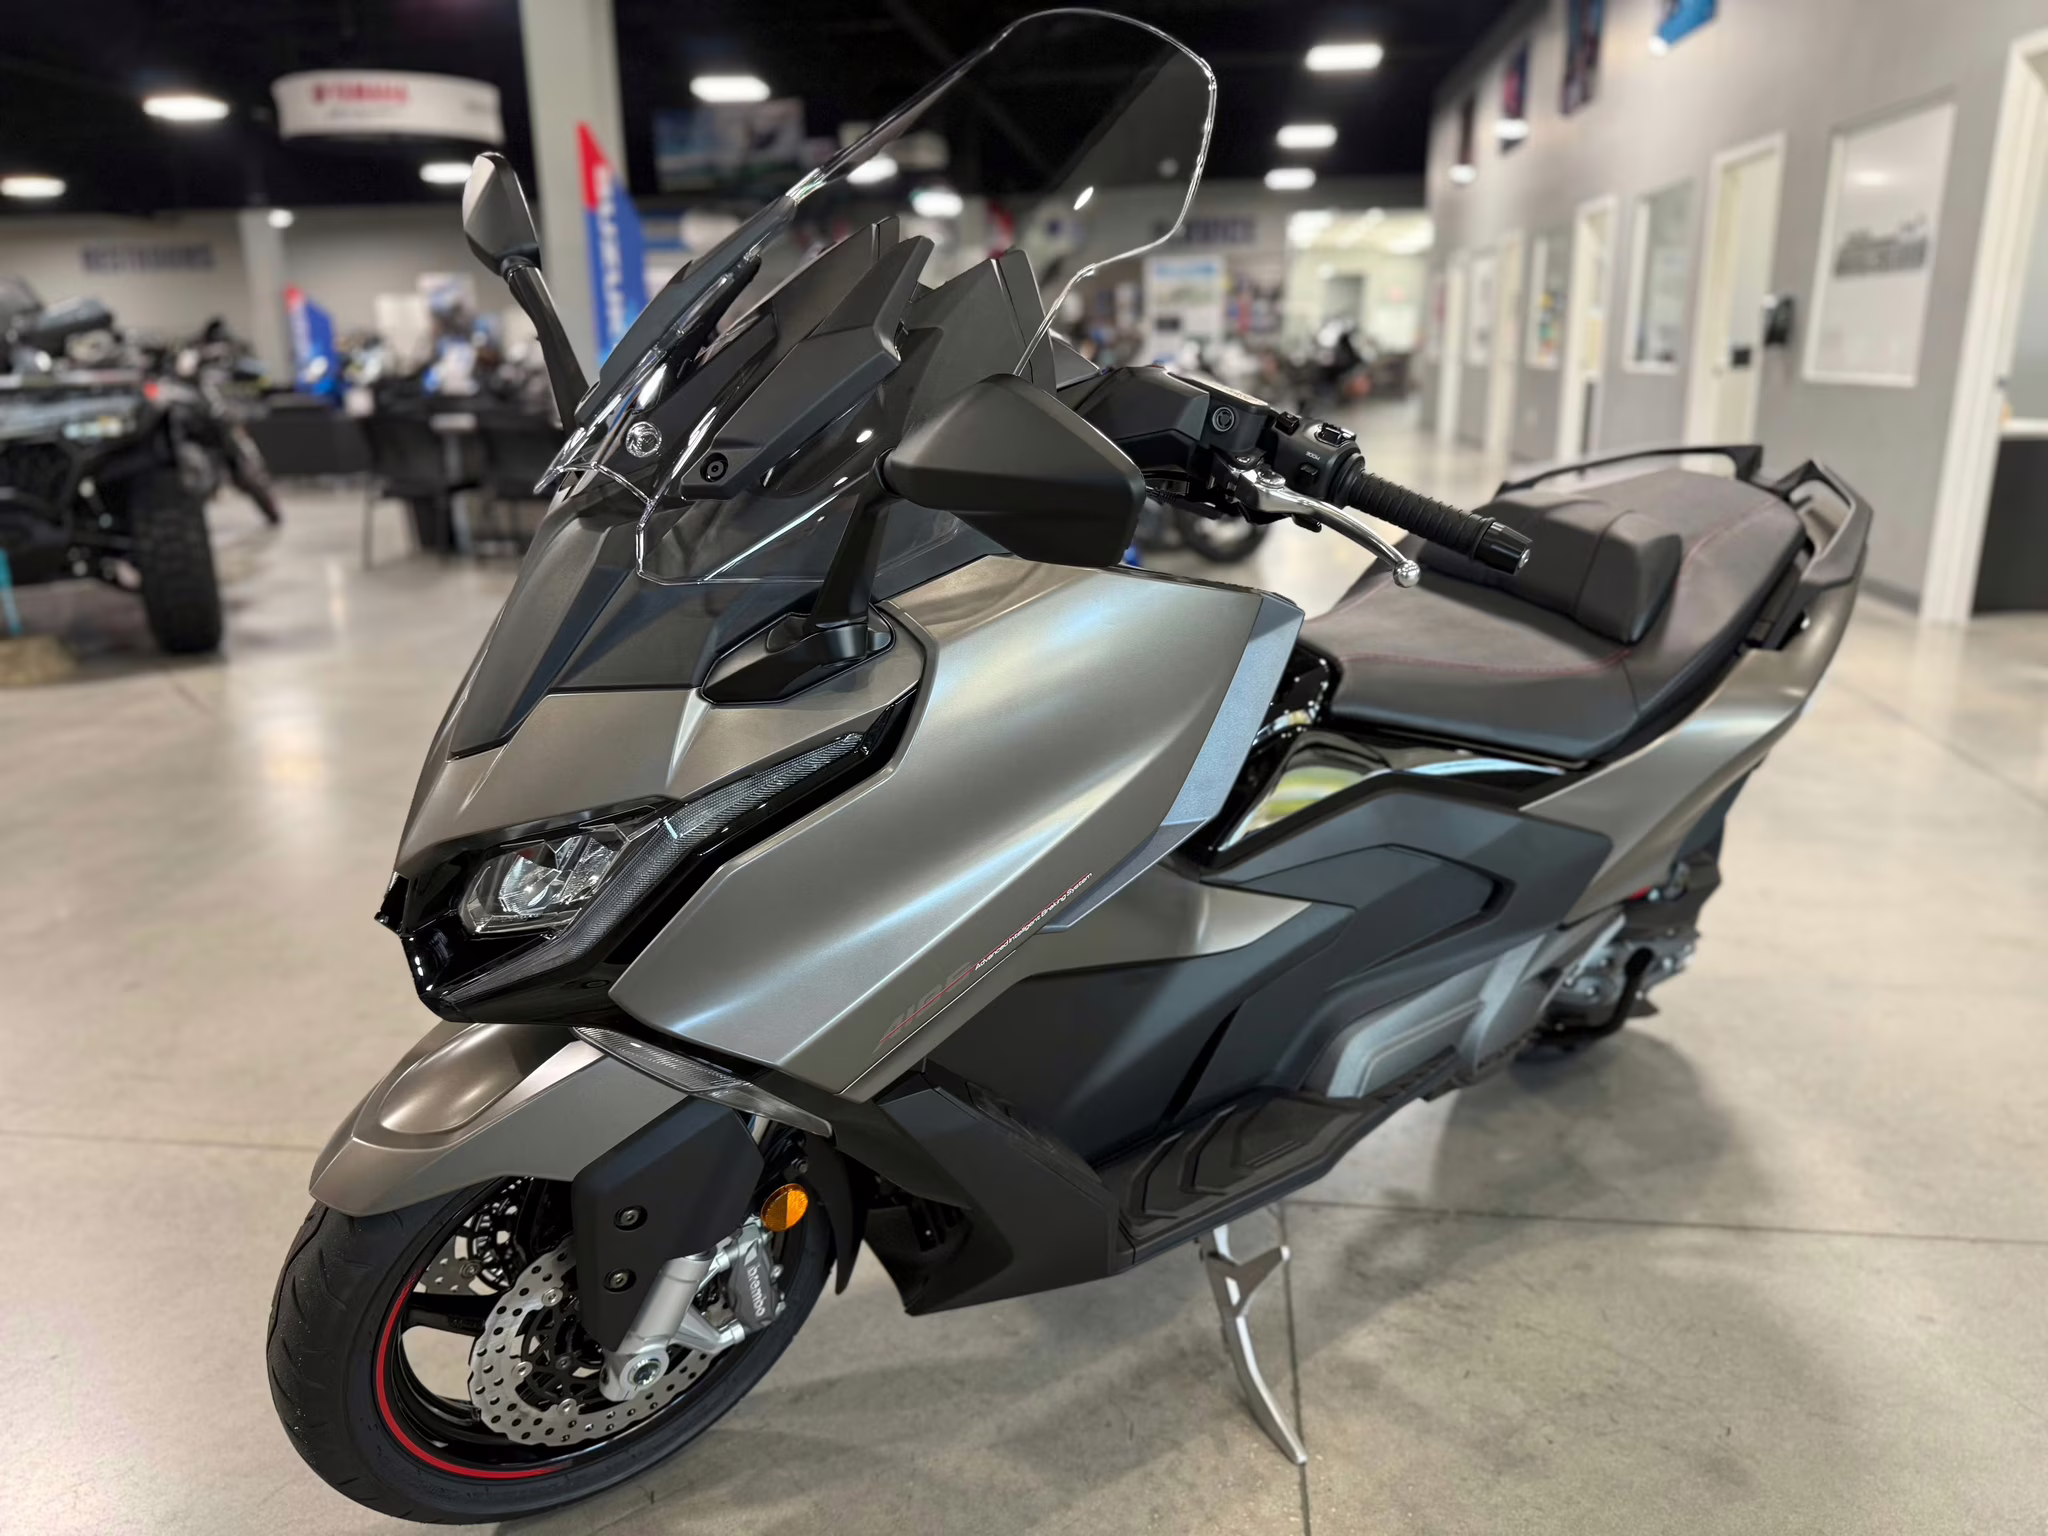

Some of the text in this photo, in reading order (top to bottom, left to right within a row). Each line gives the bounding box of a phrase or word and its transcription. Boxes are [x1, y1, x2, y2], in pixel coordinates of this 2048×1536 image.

[975, 940, 1009, 970] Advanced
[1041, 894, 1067, 917] Braking
[1066, 872, 1093, 896] System
[747, 1263, 767, 1316] brembo
